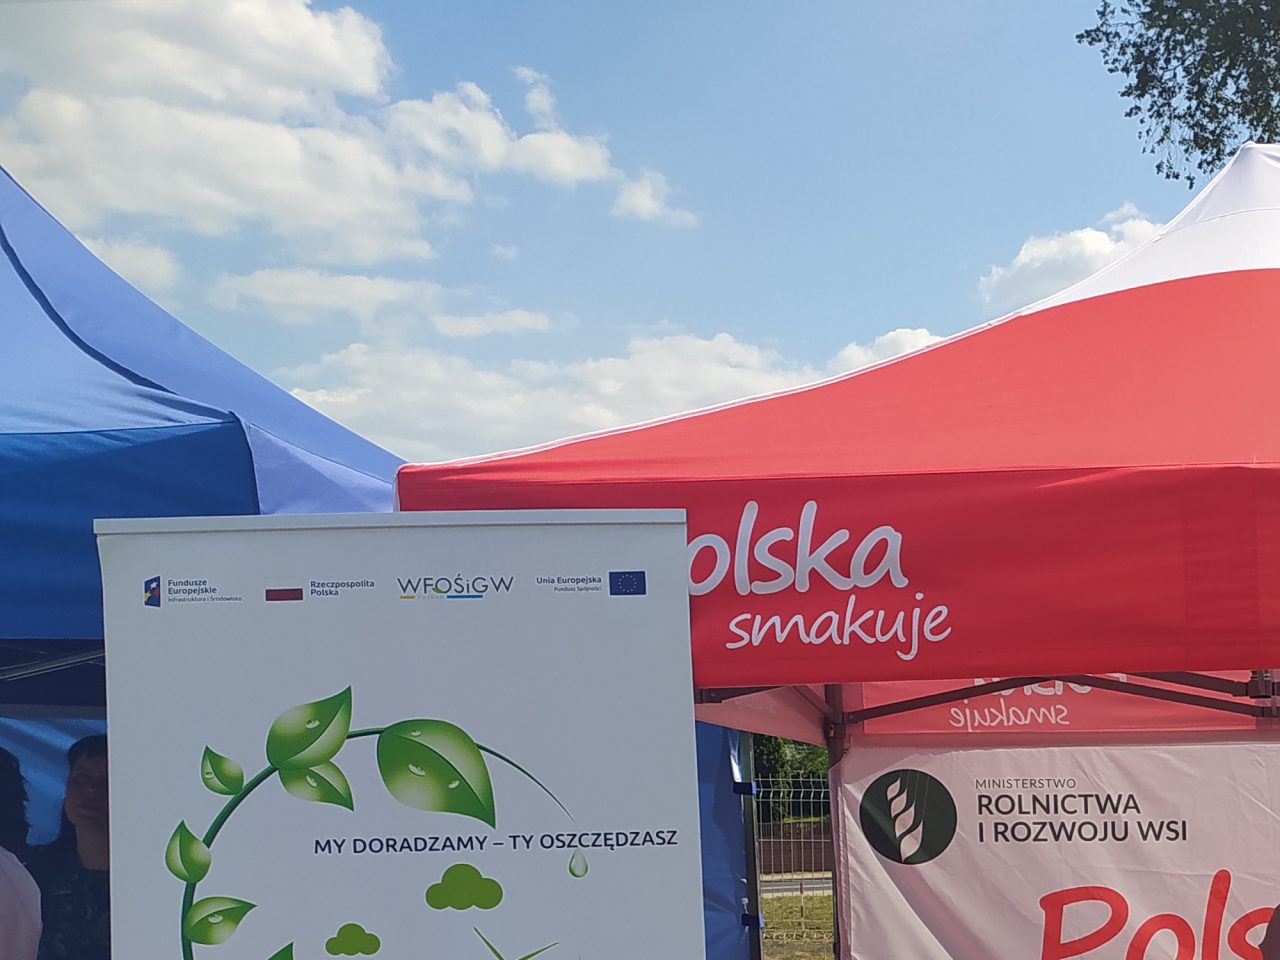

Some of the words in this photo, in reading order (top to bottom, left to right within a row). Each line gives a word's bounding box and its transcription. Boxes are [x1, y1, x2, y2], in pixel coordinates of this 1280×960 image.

[687, 500, 909, 596] olska
[168, 579, 207, 587] Fundusze
[168, 586, 217, 595] Europejskie
[310, 580, 375, 589] Rzeczpospolita
[397, 573, 514, 595] WFOŚiGW
[536, 576, 555, 584] Unia
[557, 576, 602, 585] Europejska
[726, 592, 952, 661] smakuje
[975, 777, 1077, 790] MINISTERSTWO
[977, 793, 1141, 815] ROLNICTWA
[314, 838, 346, 855] MY
[352, 835, 488, 854] DORADZAMY
[509, 834, 534, 850] TY
[539, 830, 679, 852] OSZCZĘDZASZ
[978, 822, 985, 843] I
[994, 820, 1129, 843] ROZWOJU
[1139, 820, 1188, 842] WSI
